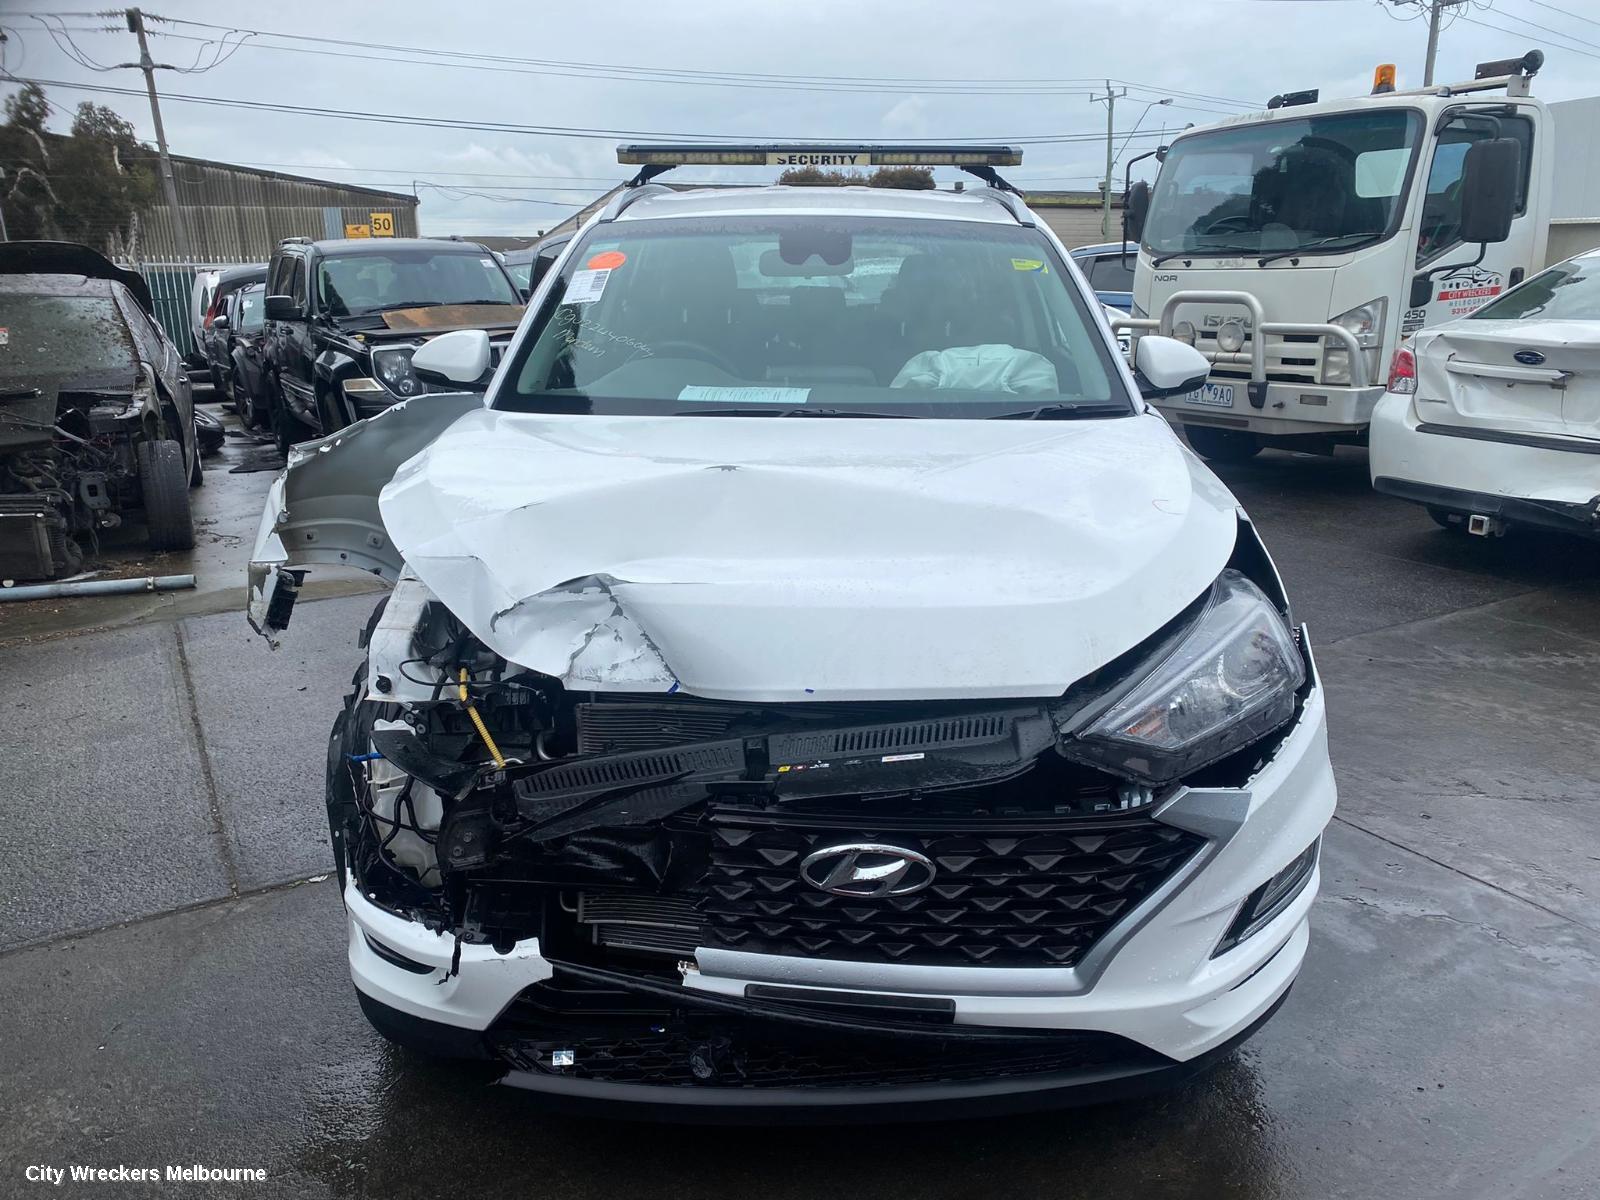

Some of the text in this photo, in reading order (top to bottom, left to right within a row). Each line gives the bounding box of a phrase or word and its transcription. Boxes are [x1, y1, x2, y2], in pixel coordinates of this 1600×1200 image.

[777, 155, 858, 165] SECURITY
[374, 218, 391, 230] 50
[1448, 288, 1492, 299] CITY WRECKERS
[1404, 310, 1426, 319] 450
